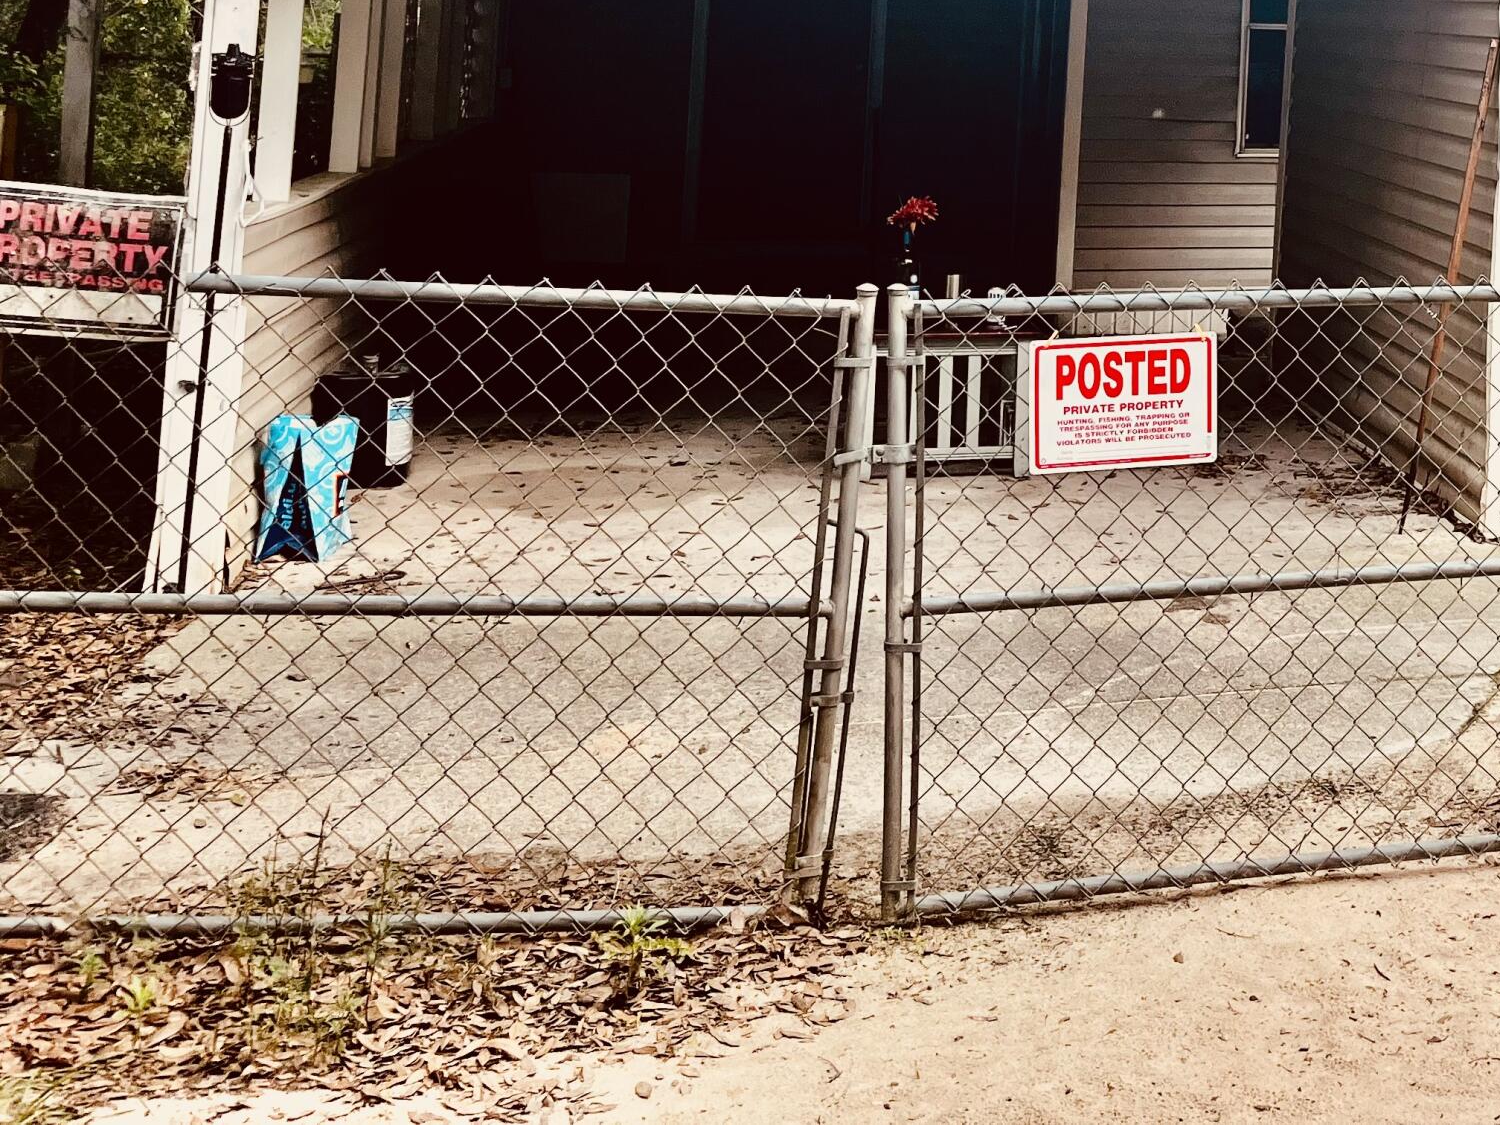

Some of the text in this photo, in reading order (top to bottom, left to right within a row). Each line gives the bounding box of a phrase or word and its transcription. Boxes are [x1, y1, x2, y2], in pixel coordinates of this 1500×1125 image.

[0, 199, 153, 240] PRIVATE
[8, 268, 164, 291] TRESPASSNG
[1056, 348, 1191, 400] POSTED
[1063, 399, 1184, 415] PRIVATE PROPERTY
[1135, 413, 1176, 421] TRAPPING
[1060, 424, 1114, 432] TRESPASSING
[1127, 426, 1174, 434] FORBIDDEN
[1056, 438, 1102, 446] VIOLATORS
[1138, 432, 1192, 441] PROSECUTED
